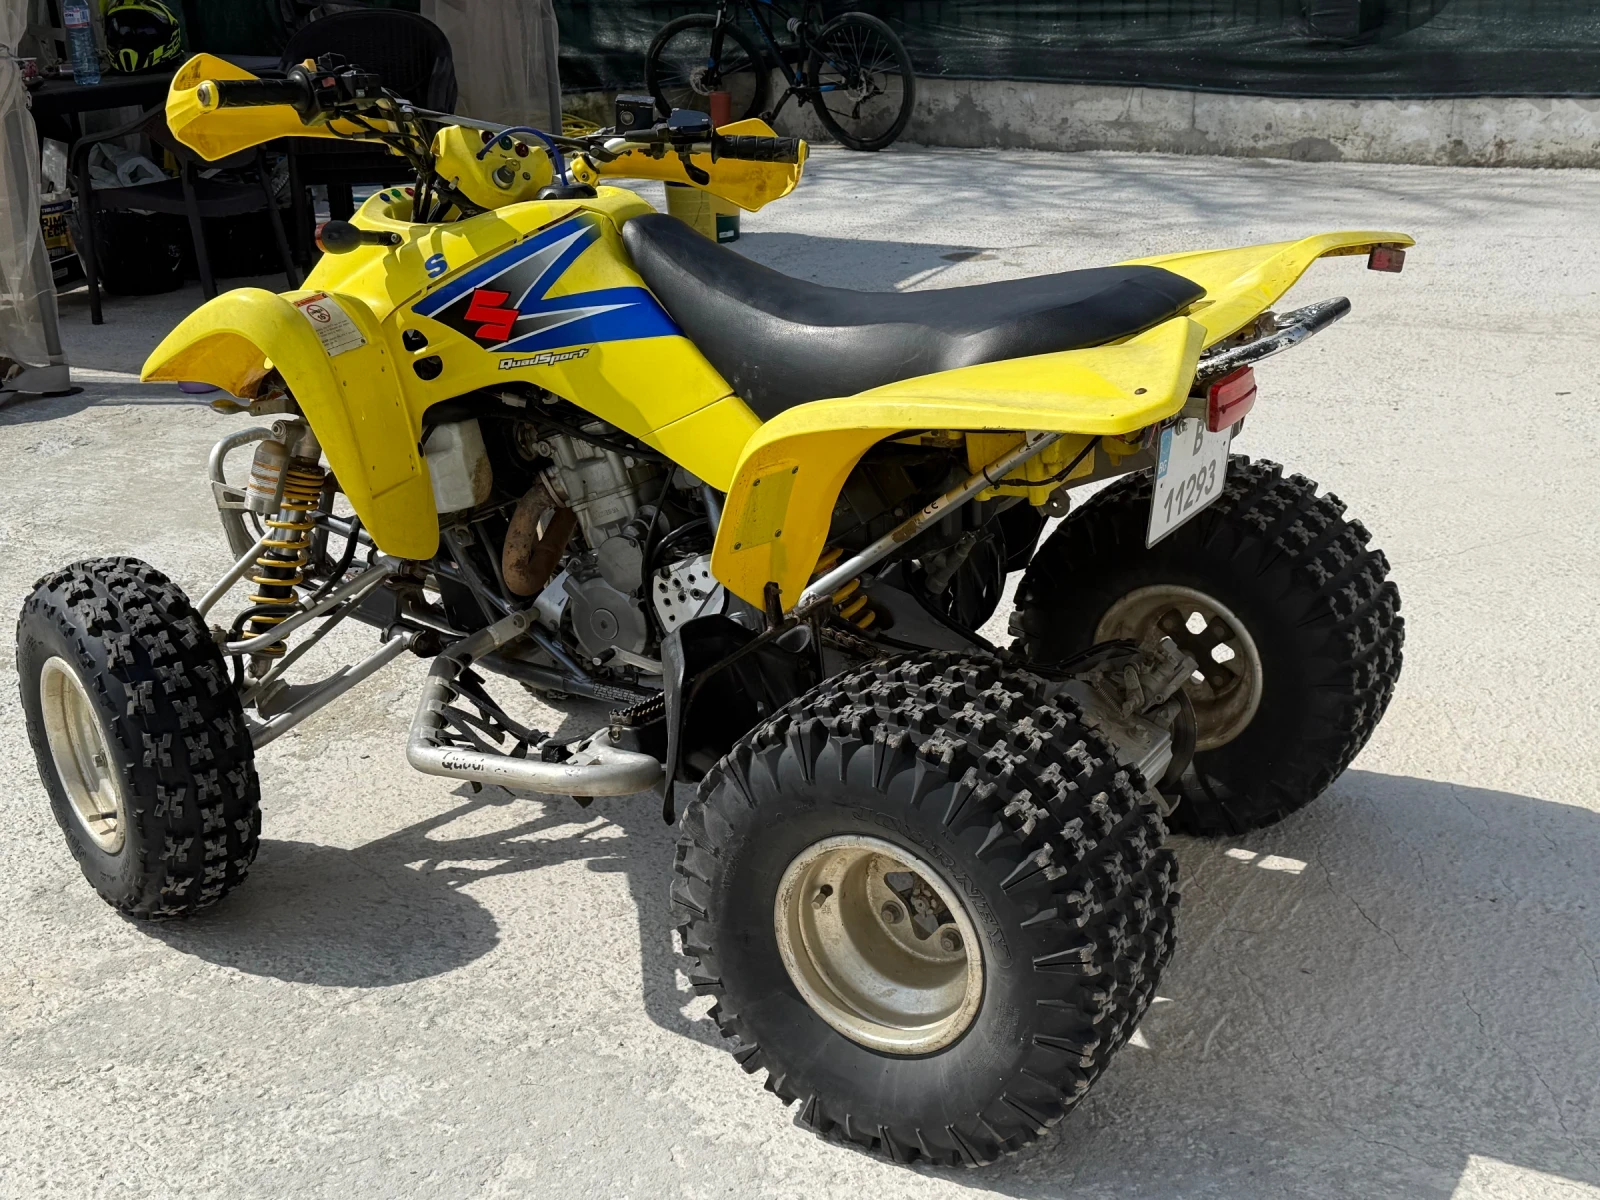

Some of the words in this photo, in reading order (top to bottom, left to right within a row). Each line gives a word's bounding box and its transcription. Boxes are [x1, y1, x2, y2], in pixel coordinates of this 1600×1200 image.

[425, 253, 448, 278] S
[499, 349, 589, 370] QuadSport
[1193, 419, 1205, 456] B
[1164, 459, 1217, 523] 11293
[852, 806, 1012, 961] JOURNEY
